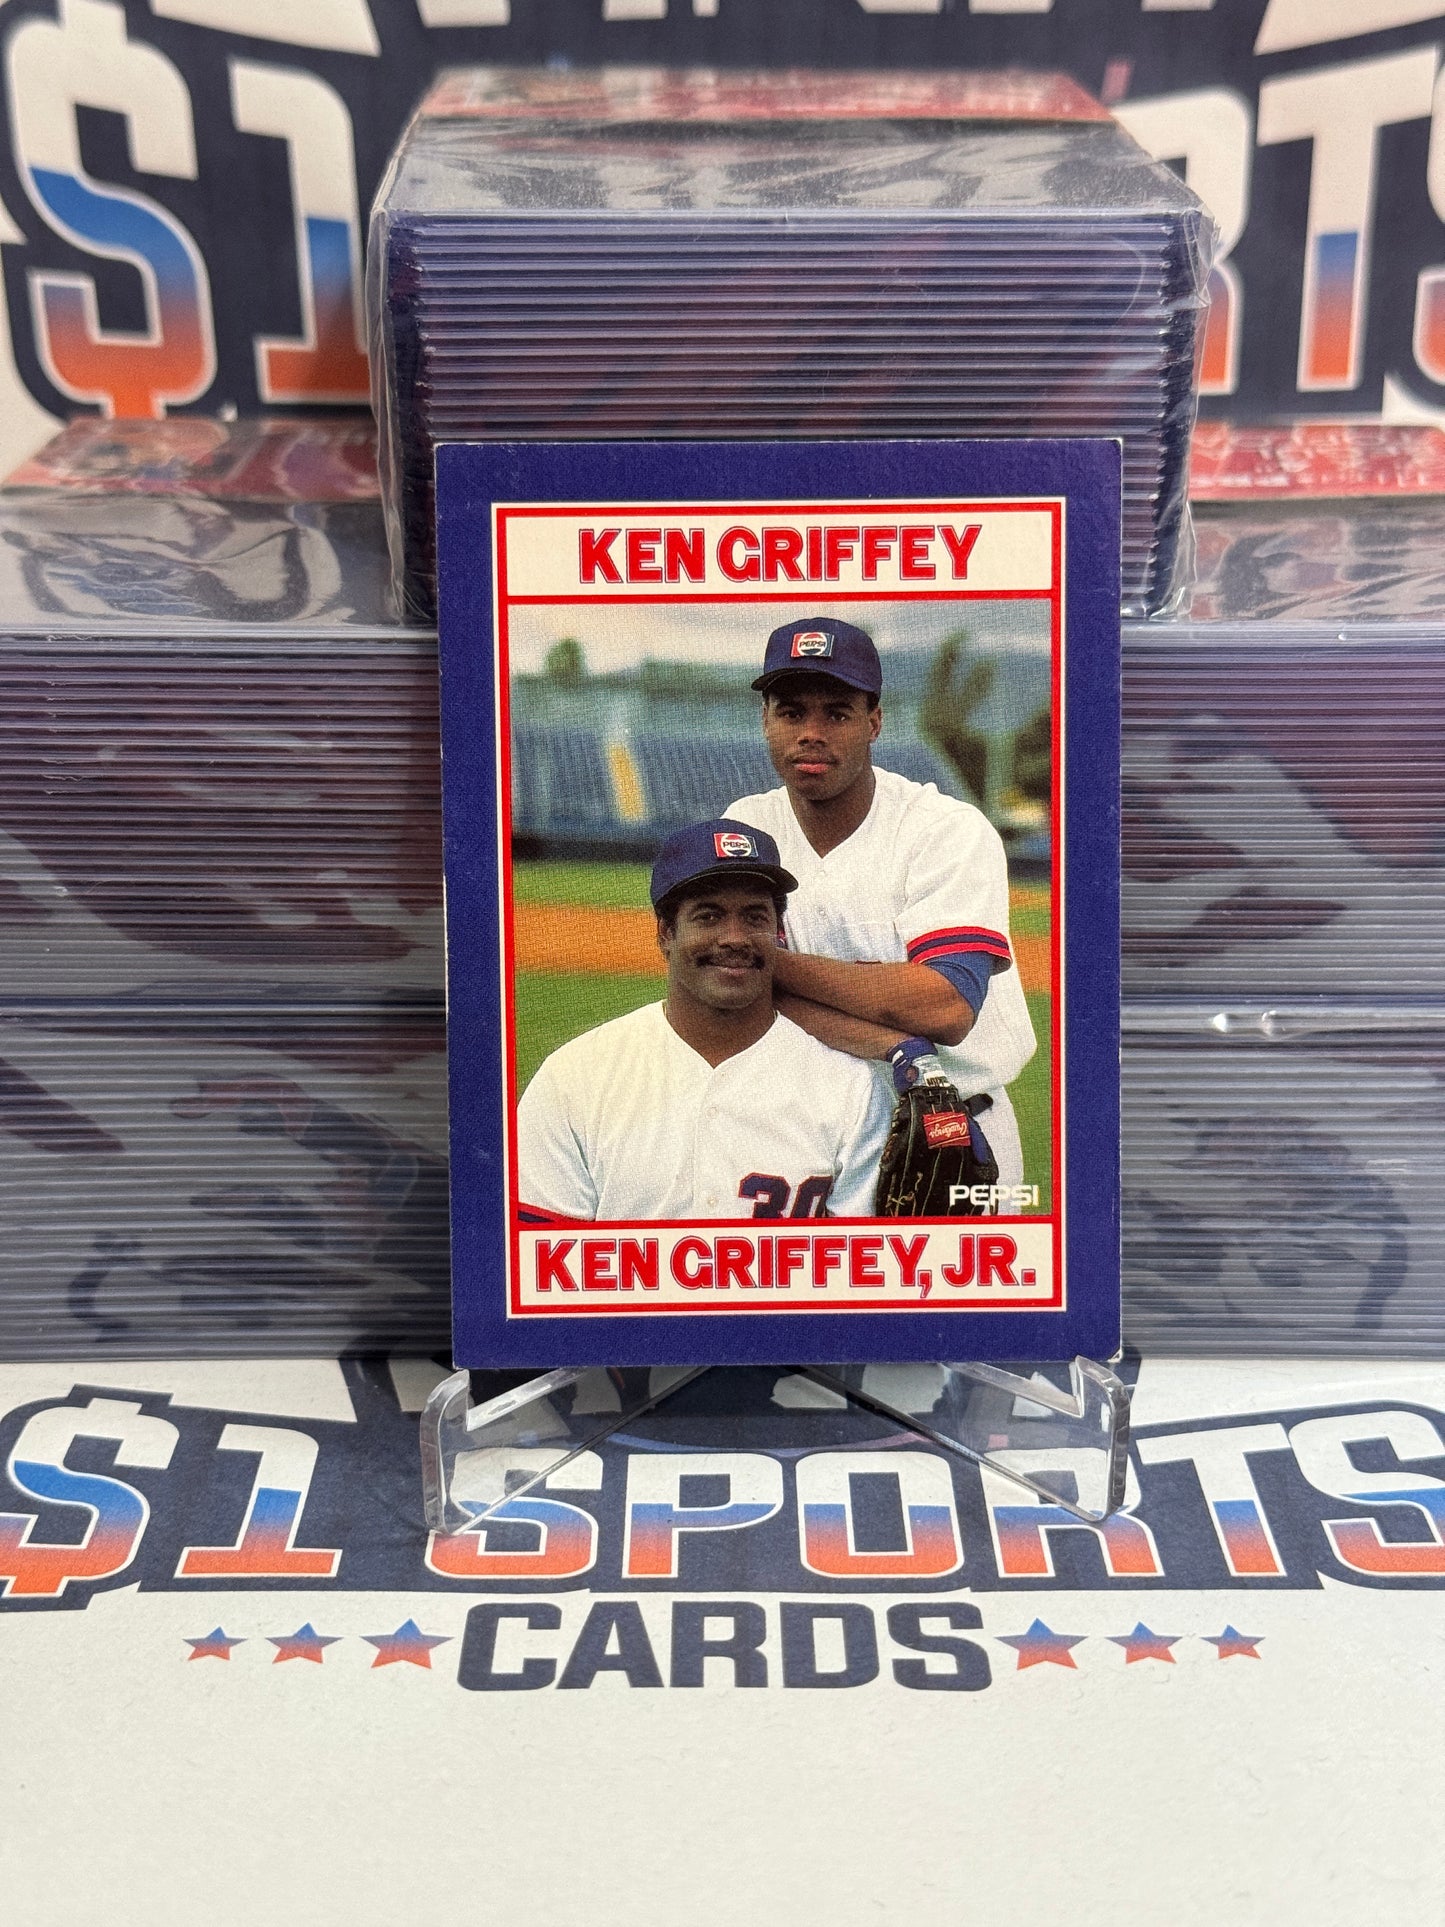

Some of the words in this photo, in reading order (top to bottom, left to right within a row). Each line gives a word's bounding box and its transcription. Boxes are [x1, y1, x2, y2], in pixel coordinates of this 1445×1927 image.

[578, 527, 706, 584] KEN
[716, 524, 983, 583] GRIFFEY
[949, 1184, 1040, 1207] PEPSI
[535, 1237, 659, 1292] KEN
[669, 1233, 932, 1299] GRIFFEY,
[941, 1233, 1037, 1288] JR.
[0, 1397, 343, 1598] $1
[423, 1409, 1445, 1580] SPORTS
[456, 1600, 993, 1692] CARDS
